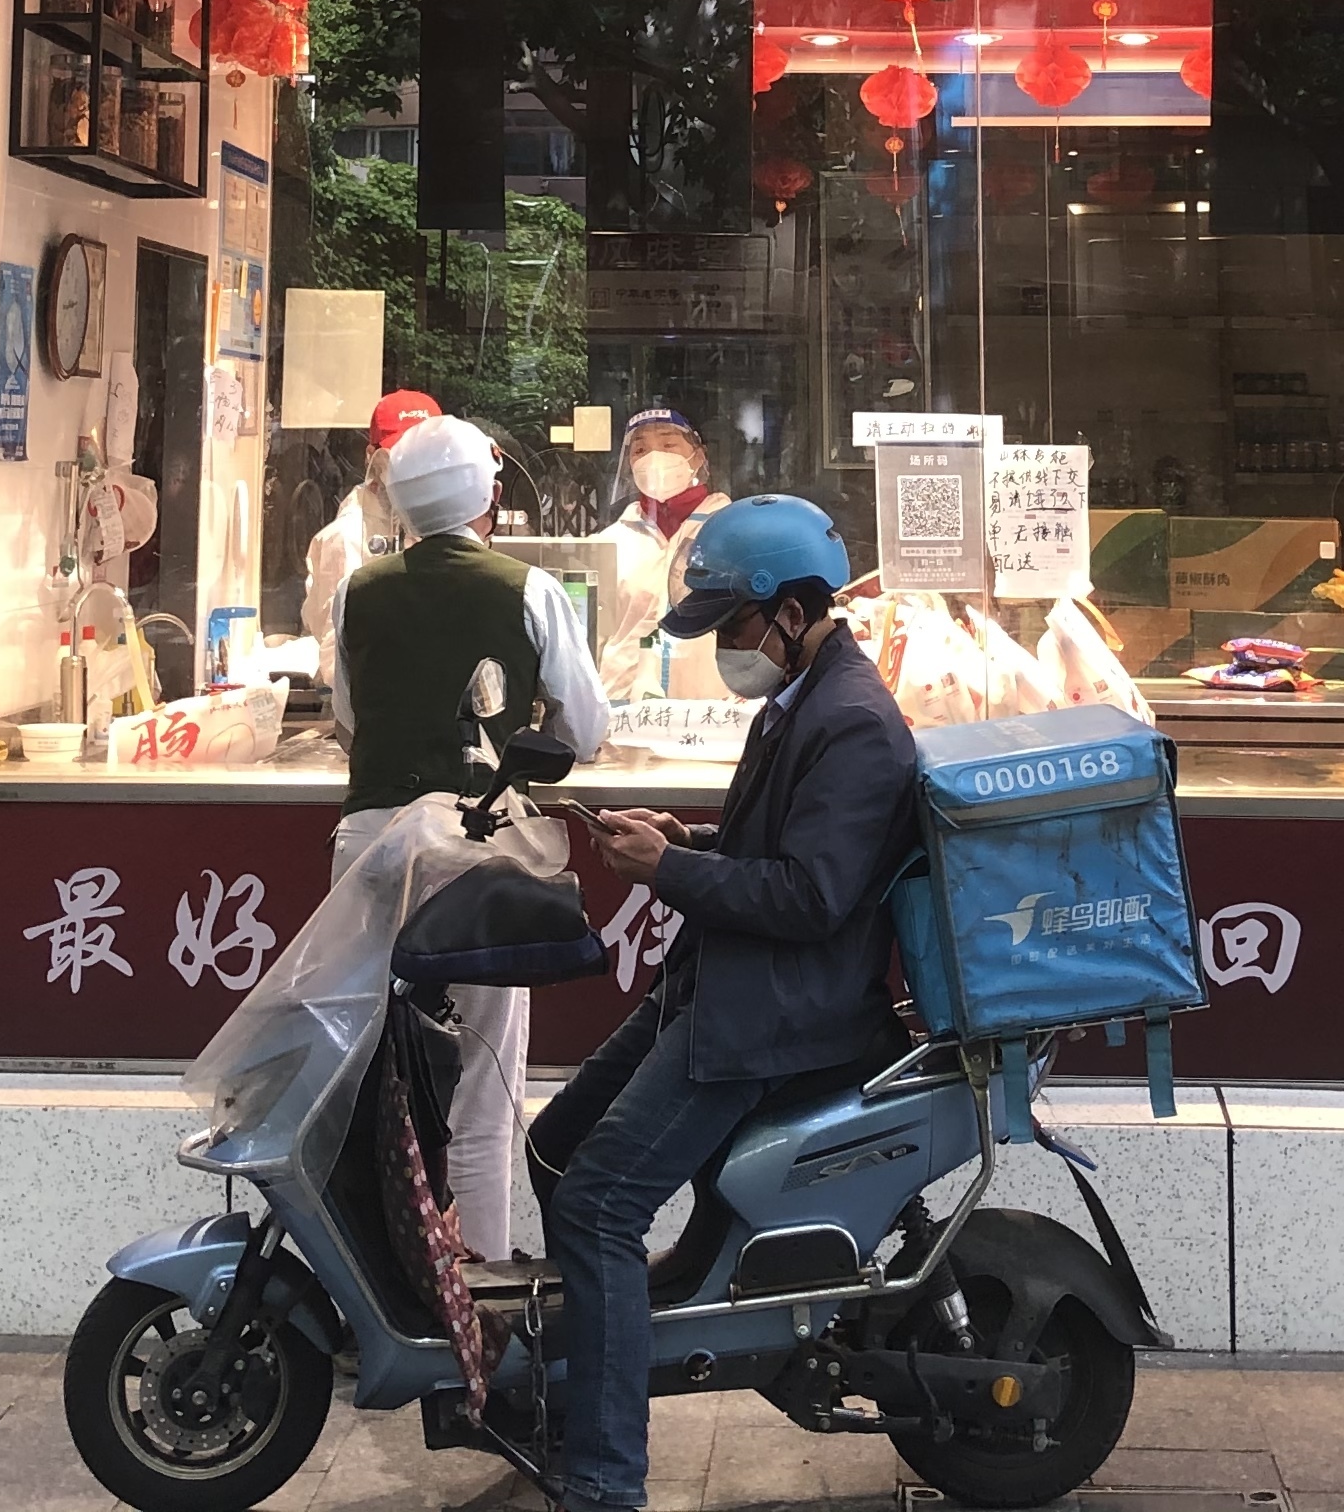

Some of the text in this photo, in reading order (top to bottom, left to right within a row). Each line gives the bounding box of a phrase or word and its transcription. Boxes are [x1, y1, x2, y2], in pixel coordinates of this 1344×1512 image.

[909, 454, 949, 467] 场所码
[973, 749, 1121, 797] 0000168
[1040, 893, 1152, 936] 蜂鸟即配
